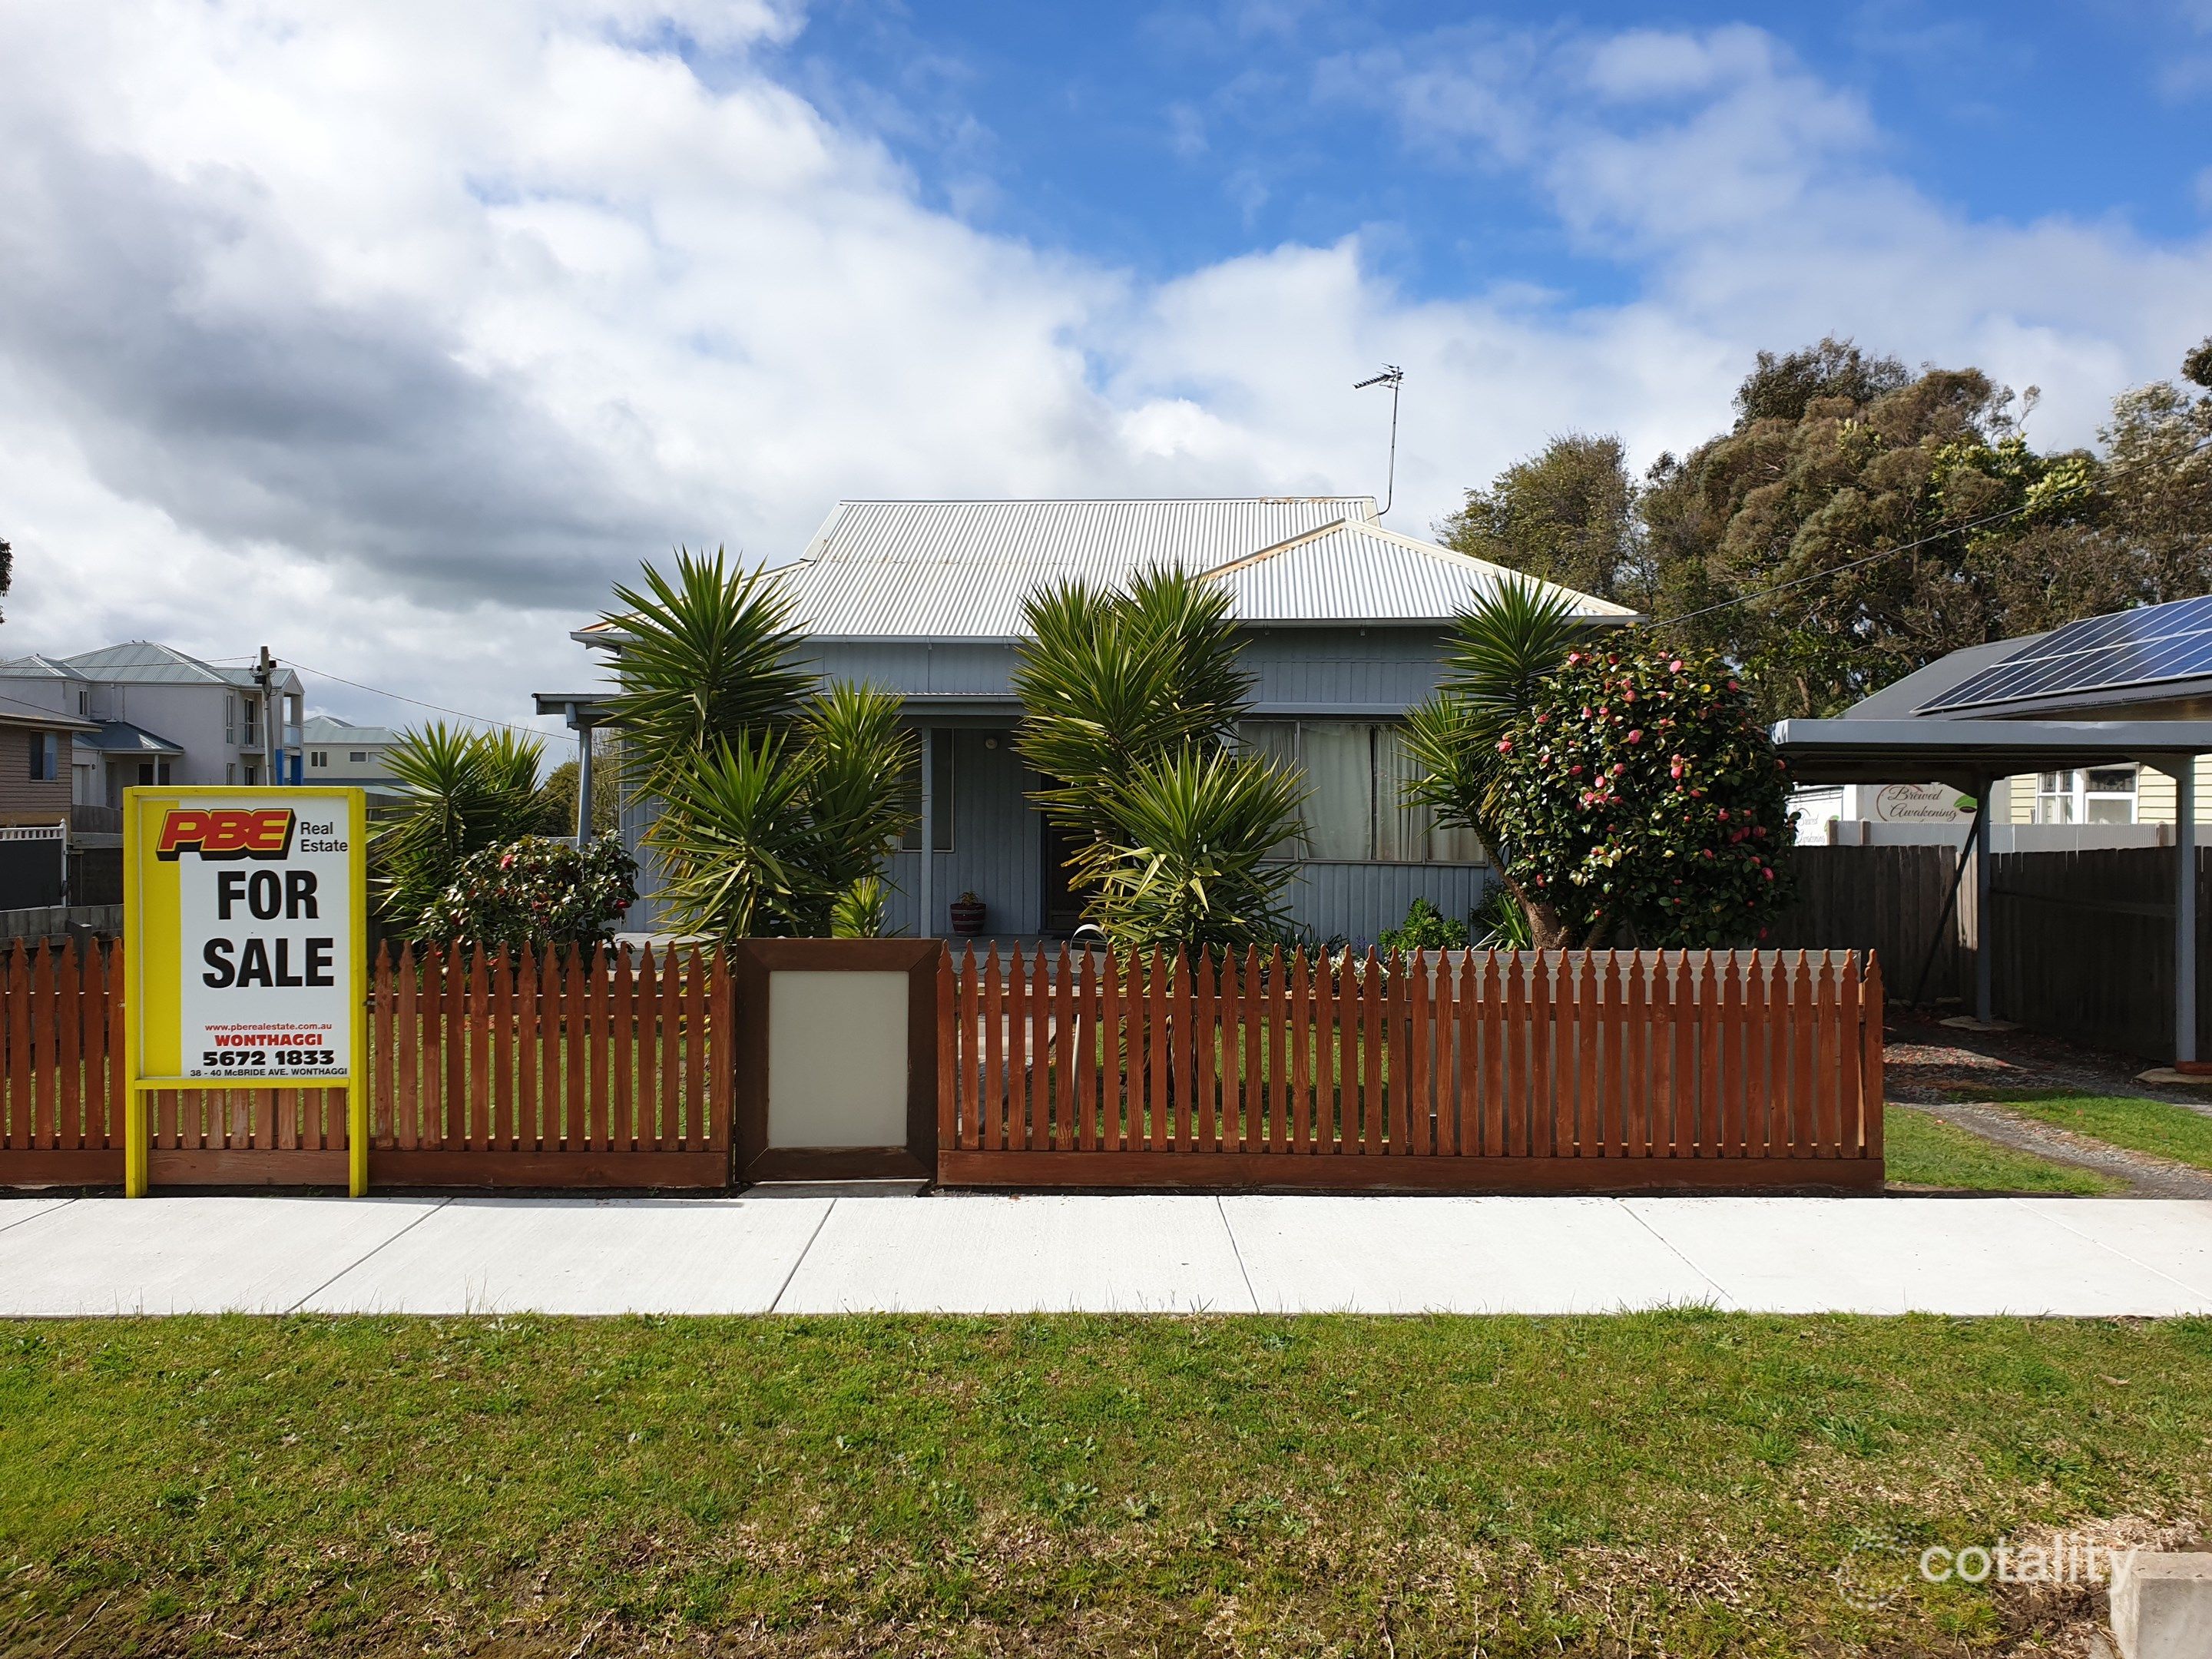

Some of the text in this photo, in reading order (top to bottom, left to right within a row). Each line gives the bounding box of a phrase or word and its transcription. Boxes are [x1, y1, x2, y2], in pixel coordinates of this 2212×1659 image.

[1888, 786, 1943, 801] Brewed
[1889, 803, 1957, 822] Awakening
[156, 809, 296, 861] PBE
[300, 821, 333, 835] Real
[300, 839, 348, 853] Estate
[217, 869, 320, 920] FOR
[202, 938, 334, 988] SALE
[205, 1023, 332, 1031] www.pberealestate.com.au
[214, 1034, 323, 1047] WONTHAGGI
[203, 1050, 335, 1066] 5672 1833
